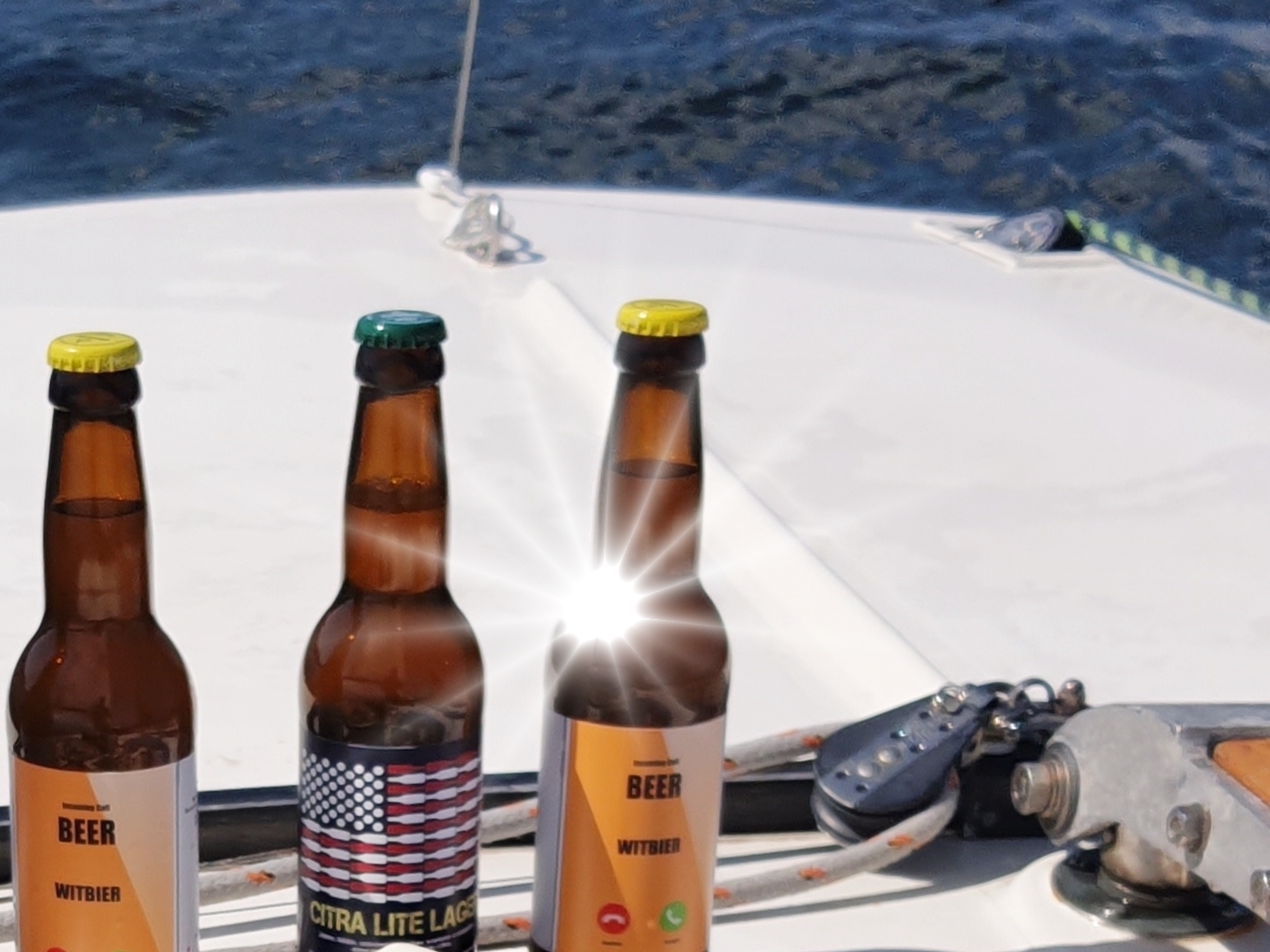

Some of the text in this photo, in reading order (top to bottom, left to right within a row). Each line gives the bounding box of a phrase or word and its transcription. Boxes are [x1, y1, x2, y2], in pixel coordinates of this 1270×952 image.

[626, 773, 682, 799] BEER
[58, 816, 116, 845] BEER
[616, 838, 681, 856] WITBIER
[55, 882, 121, 902] WITBIER
[310, 901, 368, 936] CITRA
[373, 911, 425, 937] LITE
[429, 894, 477, 932] LAGE
